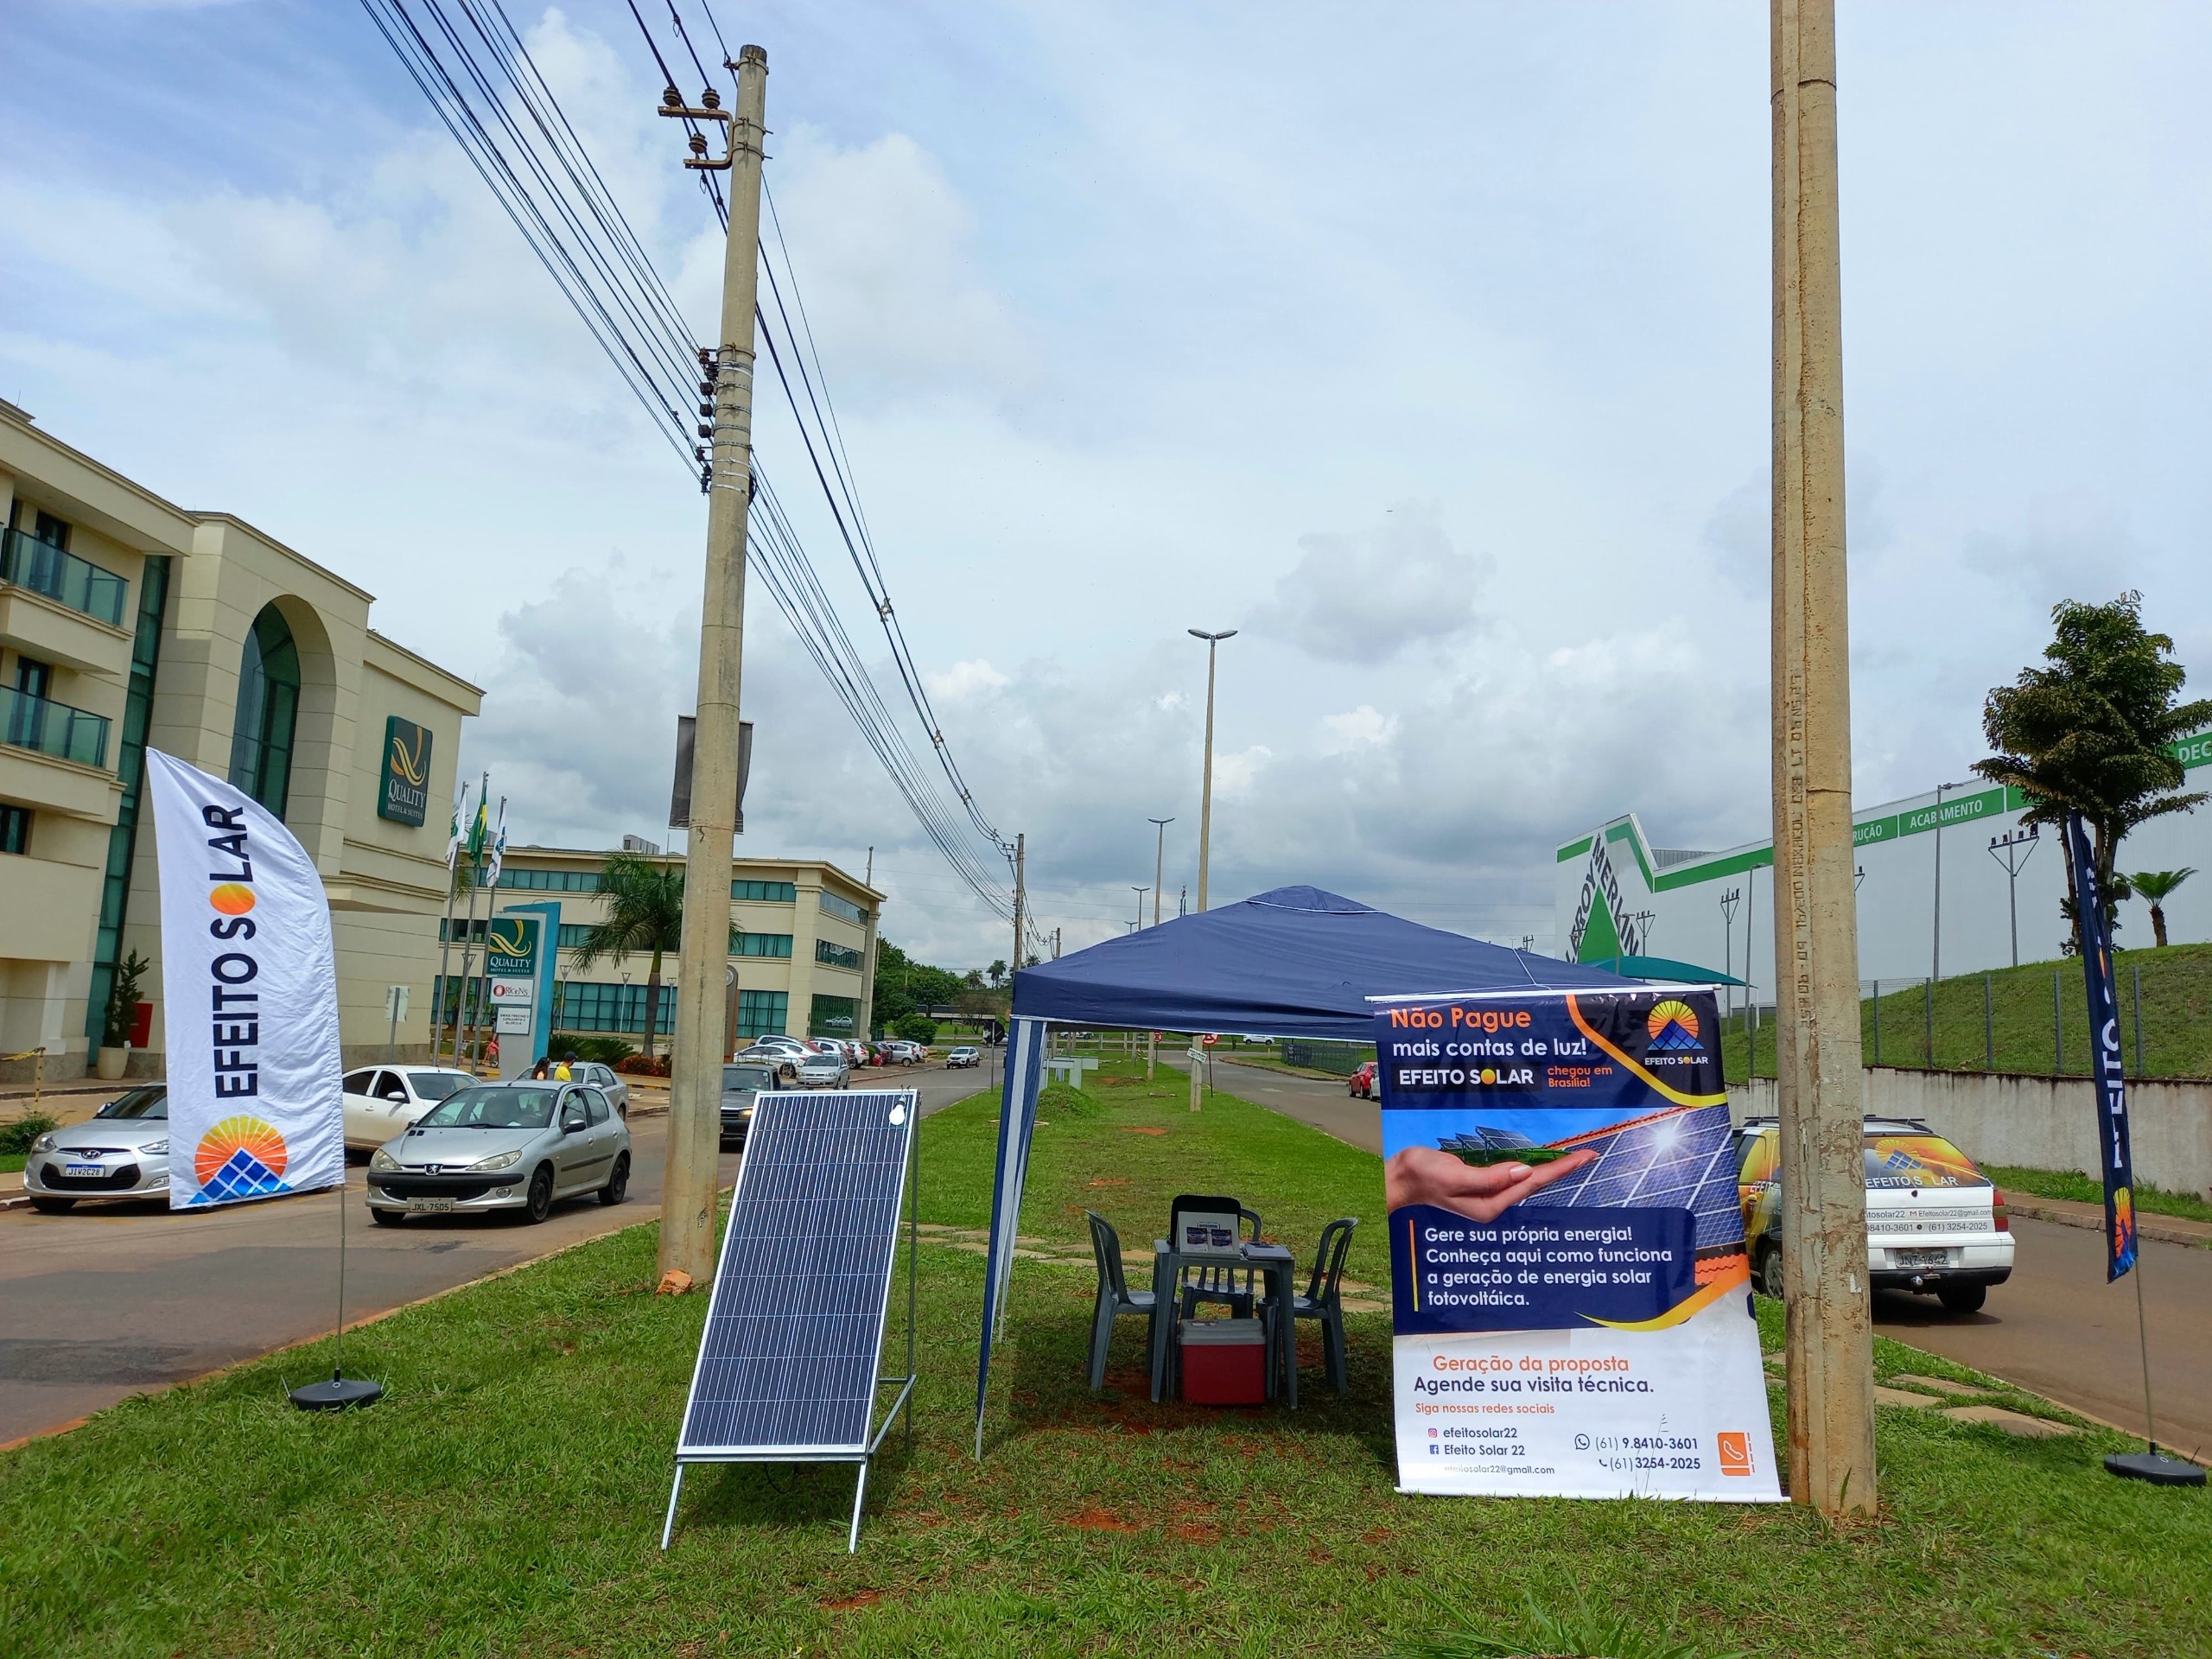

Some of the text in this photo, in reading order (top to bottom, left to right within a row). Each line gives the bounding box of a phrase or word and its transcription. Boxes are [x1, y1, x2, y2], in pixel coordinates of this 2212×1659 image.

[389, 779, 426, 808] QUALITY
[387, 803, 404, 814] HOTEL
[408, 810, 423, 820] SUITES
[1910, 799, 1983, 830] ACABAMENTO
[1592, 832, 1639, 957] MERLIN
[202, 804, 258, 1099] EFEITO SOLAR
[490, 956, 531, 968] QUALITY
[1391, 1007, 1531, 1033] Não Pague
[1393, 1039, 1586, 1056] mais contas de luz!
[1400, 1070, 1465, 1084] EFEITO
[1470, 1069, 1534, 1084] SOLAR
[1548, 1065, 1591, 1077] chegou
[1548, 1073, 1590, 1088] Brasília!
[1866, 1176, 1910, 1188] EFEITO
[1918, 1209, 1992, 1218] Efeitosolar22@gmail.com
[1425, 1226, 1632, 1244] Gere sua própria energia!
[1929, 1224, 1945, 1232] (61)
[1947, 1222, 1987, 1231] 3254-2025
[1427, 1248, 1672, 1265] Conheça aqui como funciona
[1427, 1269, 1651, 1287] a geração de energia solar
[1428, 1290, 1529, 1305] fotovoltáica.
[1433, 1356, 1629, 1375] Geração da proposta
[1414, 1376, 1654, 1395] Agende sua visita técnica.
[1416, 1403, 1439, 1414] Siga
[1483, 1403, 1513, 1413] redes
[1517, 1403, 1554, 1414] sociais
[1444, 1427, 1517, 1438] efeitosolar22
[1445, 1445, 1525, 1456] Efeito Solar 22
[1596, 1437, 1697, 1451] (61) 9.8410-3601
[1611, 1458, 1700, 1471] (61) 3254-2025
